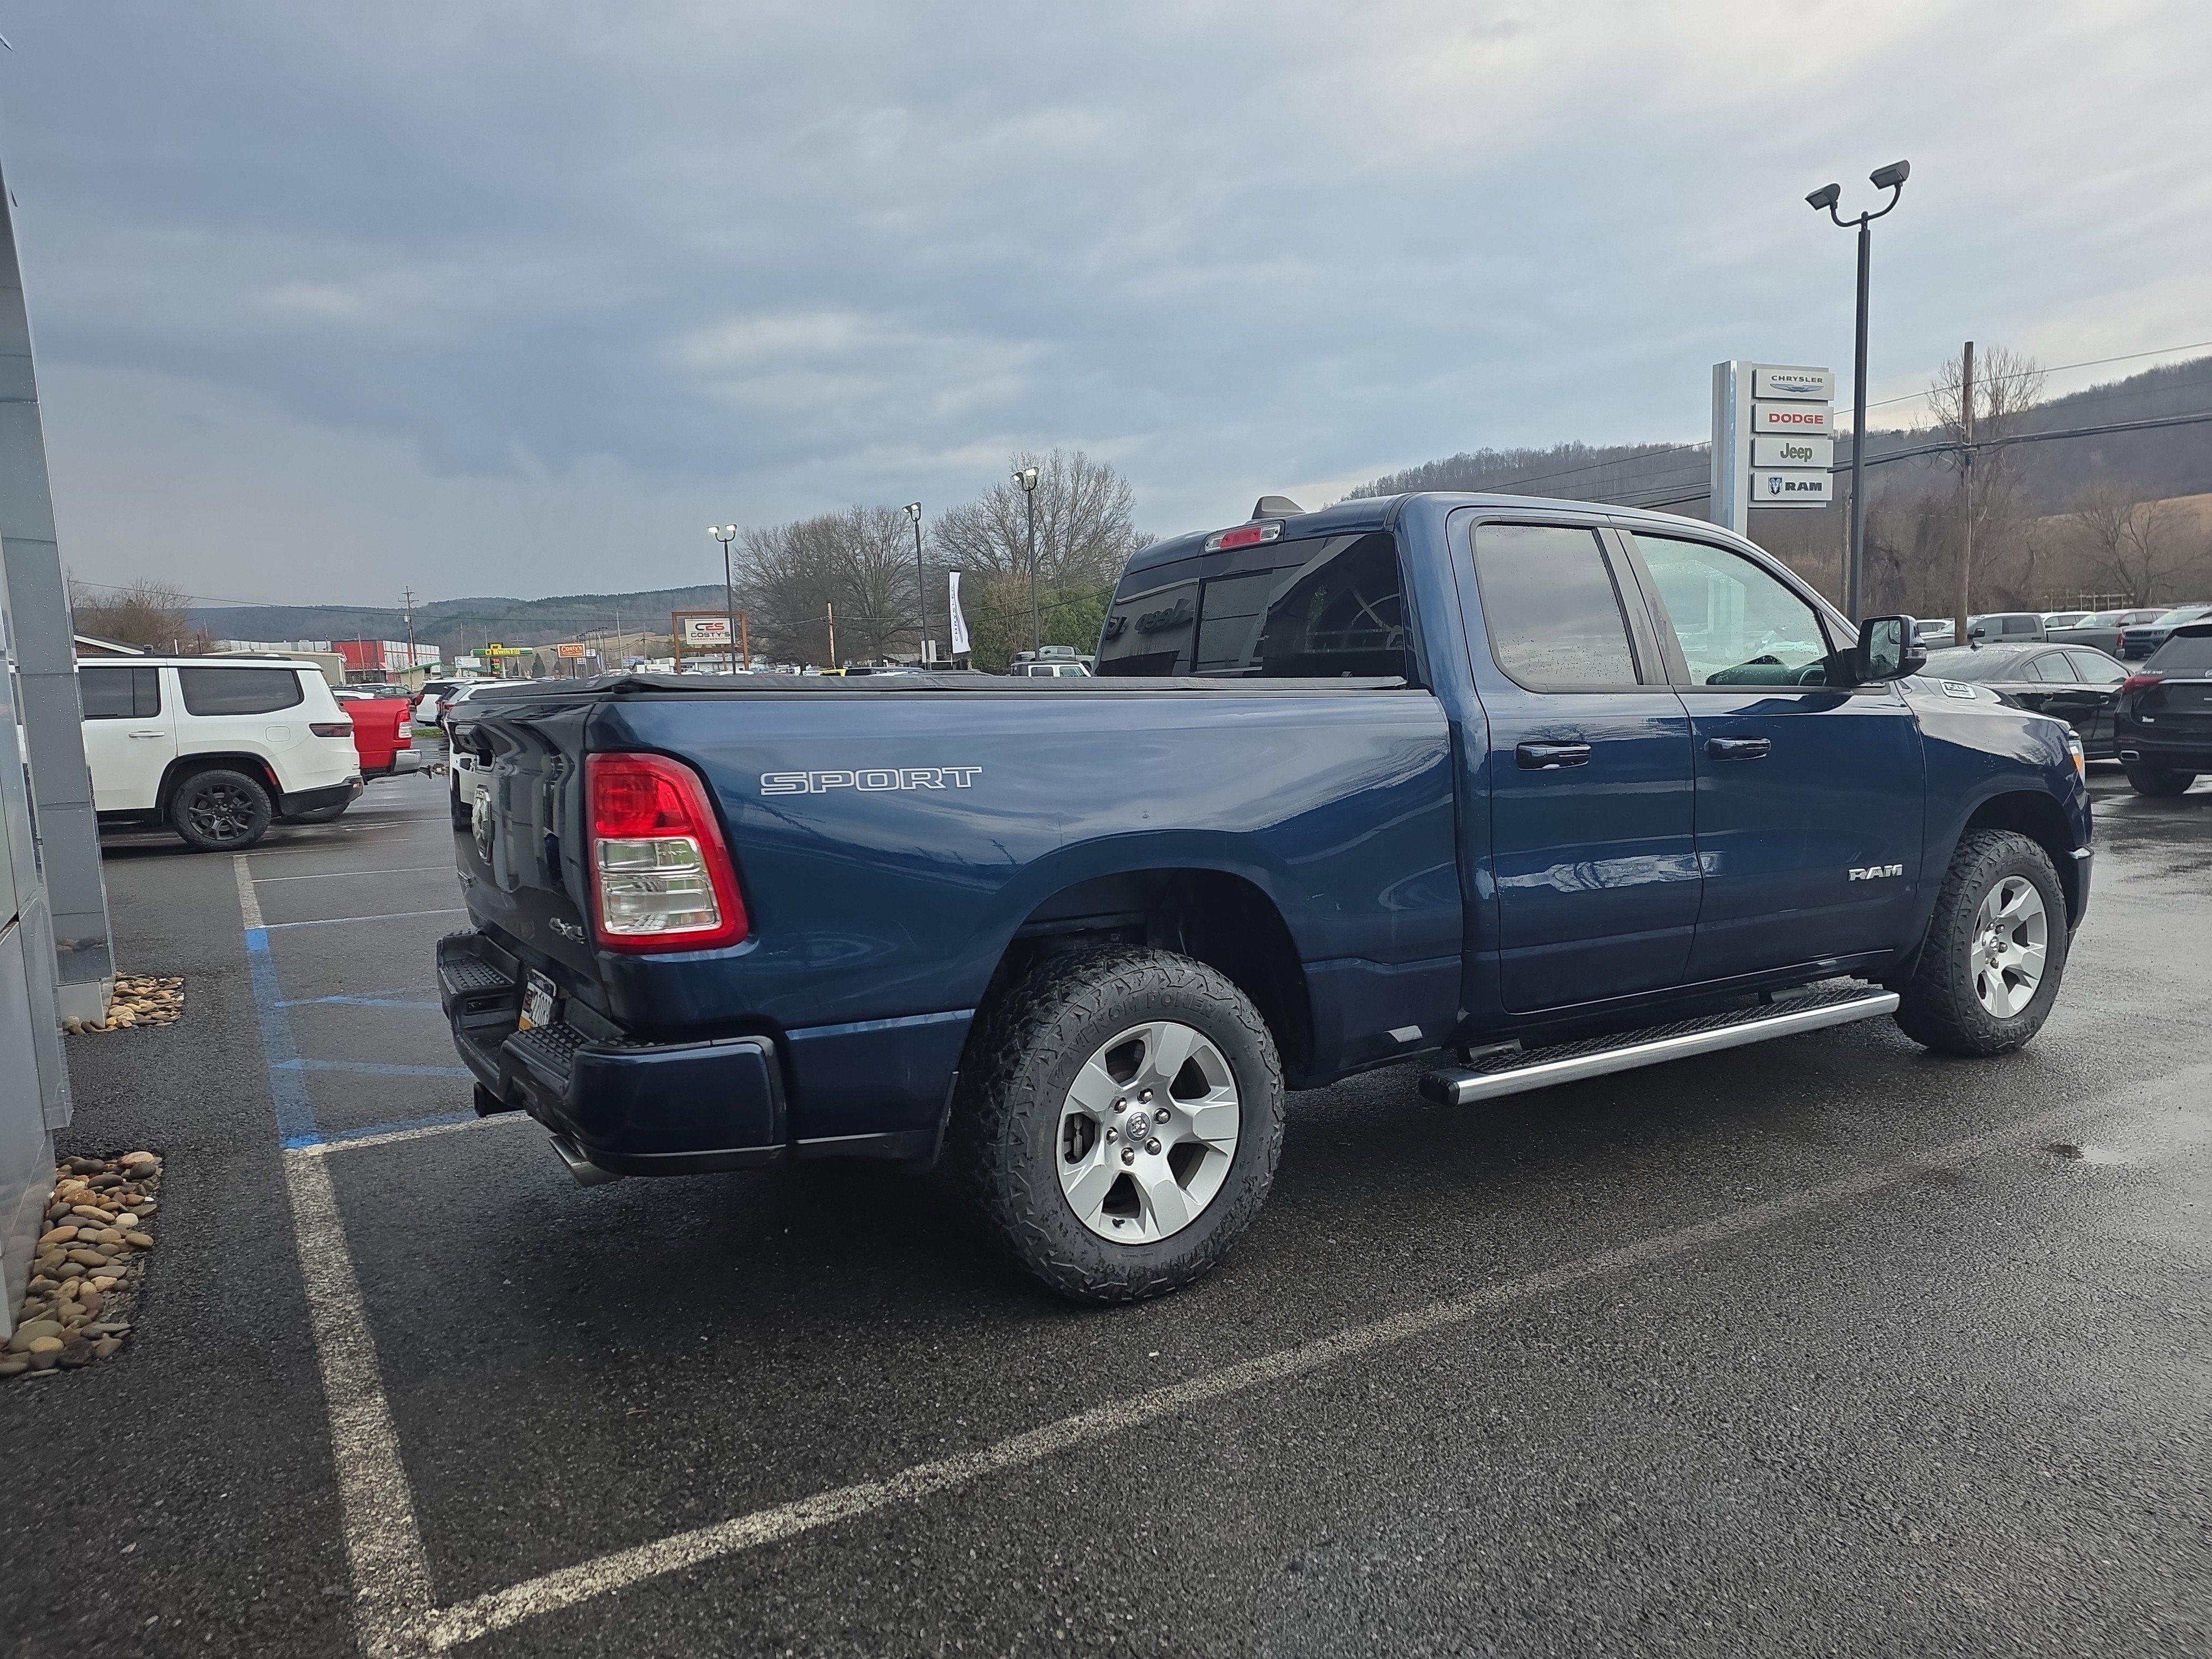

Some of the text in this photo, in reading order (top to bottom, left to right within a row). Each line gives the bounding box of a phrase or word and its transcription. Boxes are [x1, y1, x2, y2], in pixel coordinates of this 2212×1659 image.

[1769, 414, 1823, 424] DODGE
[1780, 442, 1813, 462] Jeep
[1785, 482, 1822, 491] RAM
[695, 622, 725, 631] CES
[760, 767, 982, 795] SPORT
[1848, 864, 1903, 882] RAM
[1146, 989, 1218, 1019] POWER
